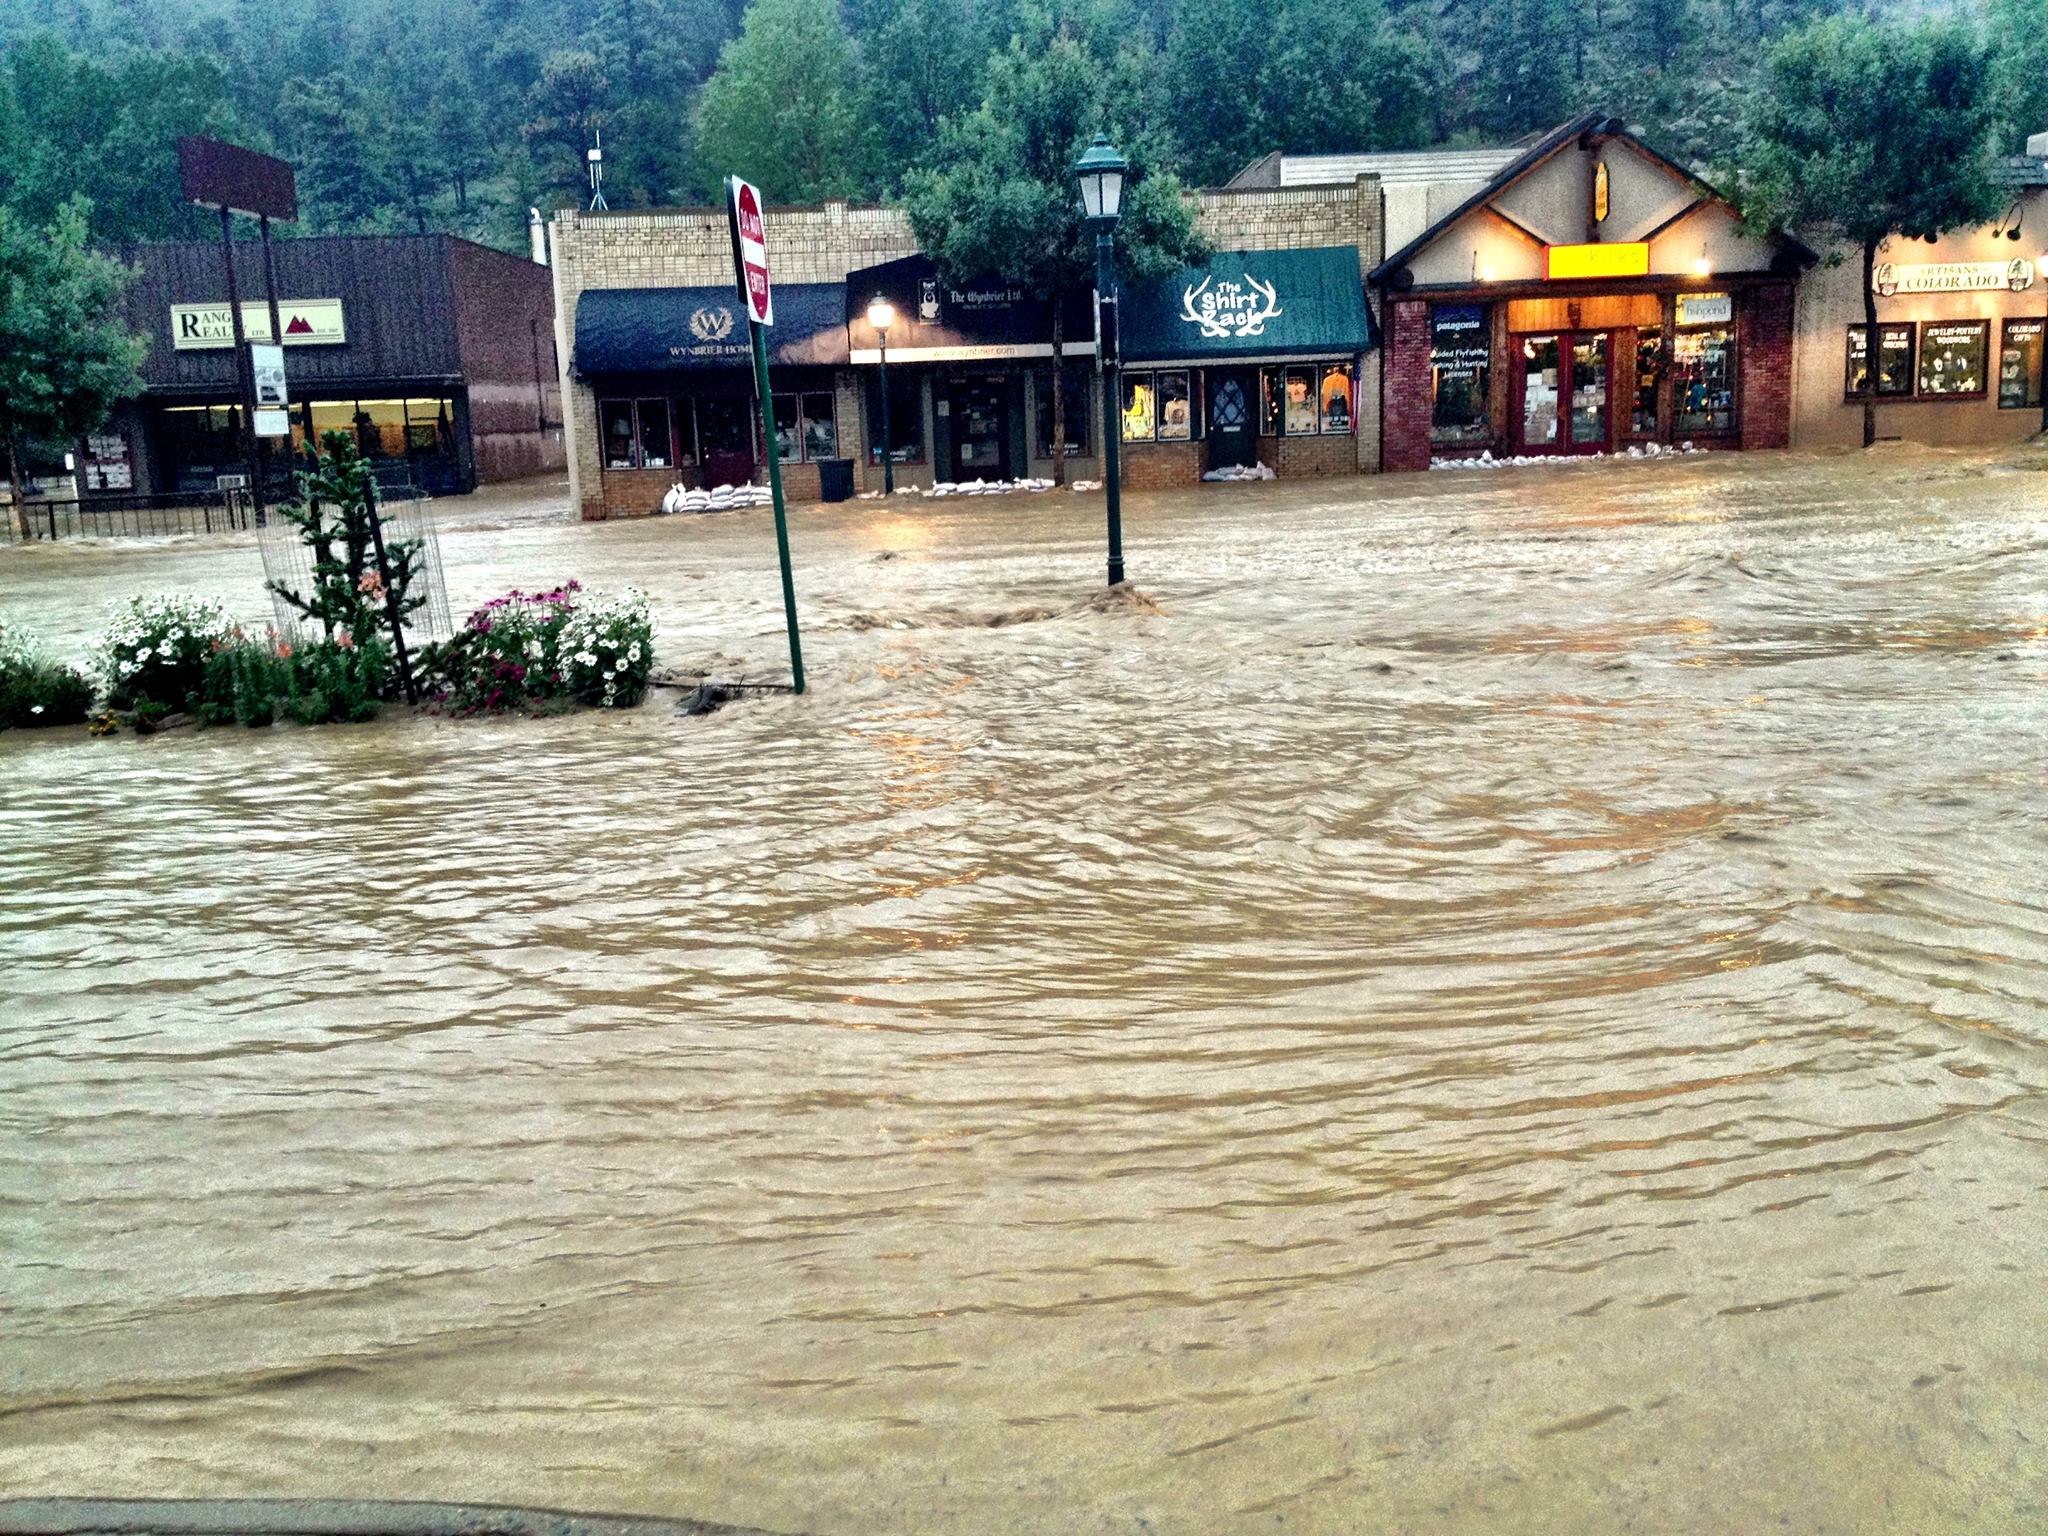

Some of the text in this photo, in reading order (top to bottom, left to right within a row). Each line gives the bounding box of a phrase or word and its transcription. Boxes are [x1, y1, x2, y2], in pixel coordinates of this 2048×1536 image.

[740, 208, 761, 236] DO NOT
[750, 270, 766, 295] ENTER
[1217, 281, 1241, 294] The
[1906, 274, 1999, 290] COLORADO
[950, 291, 965, 303] The
[1201, 292, 1259, 310] Shirt
[699, 313, 726, 332] W
[1202, 308, 1264, 327] Rack
[1436, 320, 1480, 332] patagonia
[669, 345, 722, 356] WYNBRIER
[1461, 360, 1489, 369] Hunting
